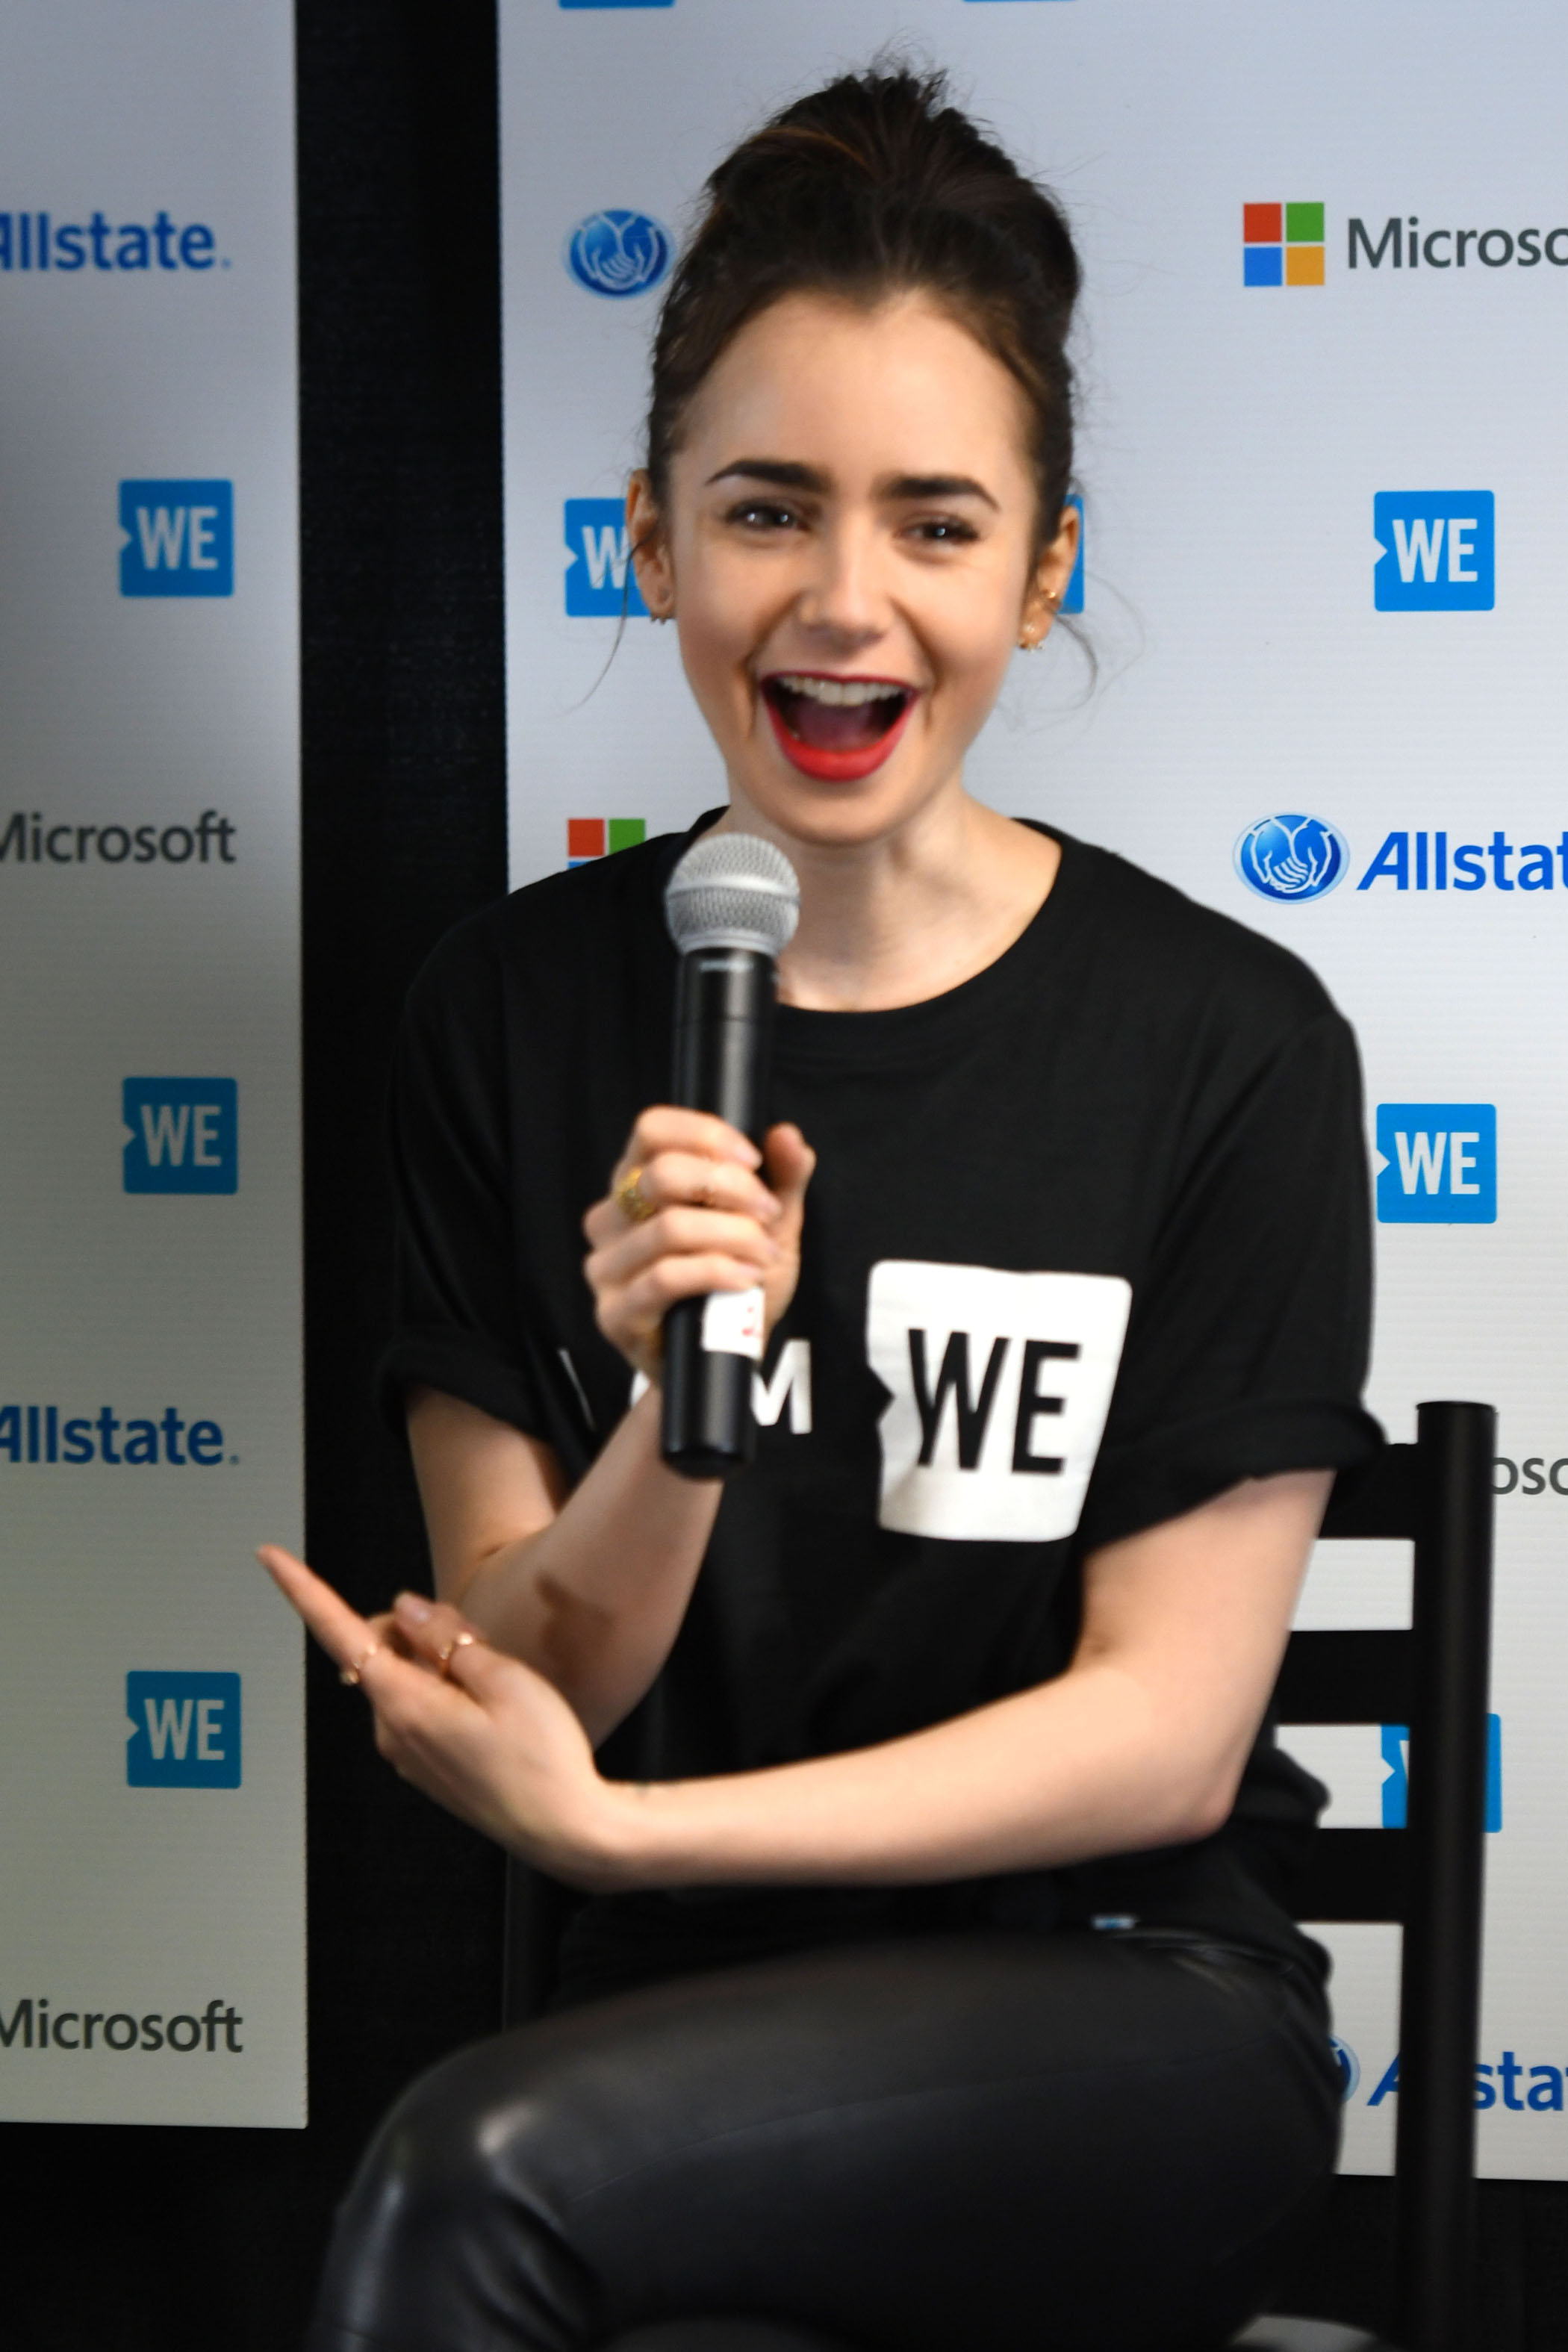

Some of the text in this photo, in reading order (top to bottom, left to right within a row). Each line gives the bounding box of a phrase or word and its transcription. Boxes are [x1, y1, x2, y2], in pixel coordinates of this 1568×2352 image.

[137, 507, 217, 570] WE
[582, 525, 633, 590] W
[1393, 518, 1478, 583] WE
[141, 1104, 222, 1166] WE
[1395, 1131, 1481, 1195] WE
[907, 1328, 1082, 1476] WE
[144, 1698, 225, 1761] WE
